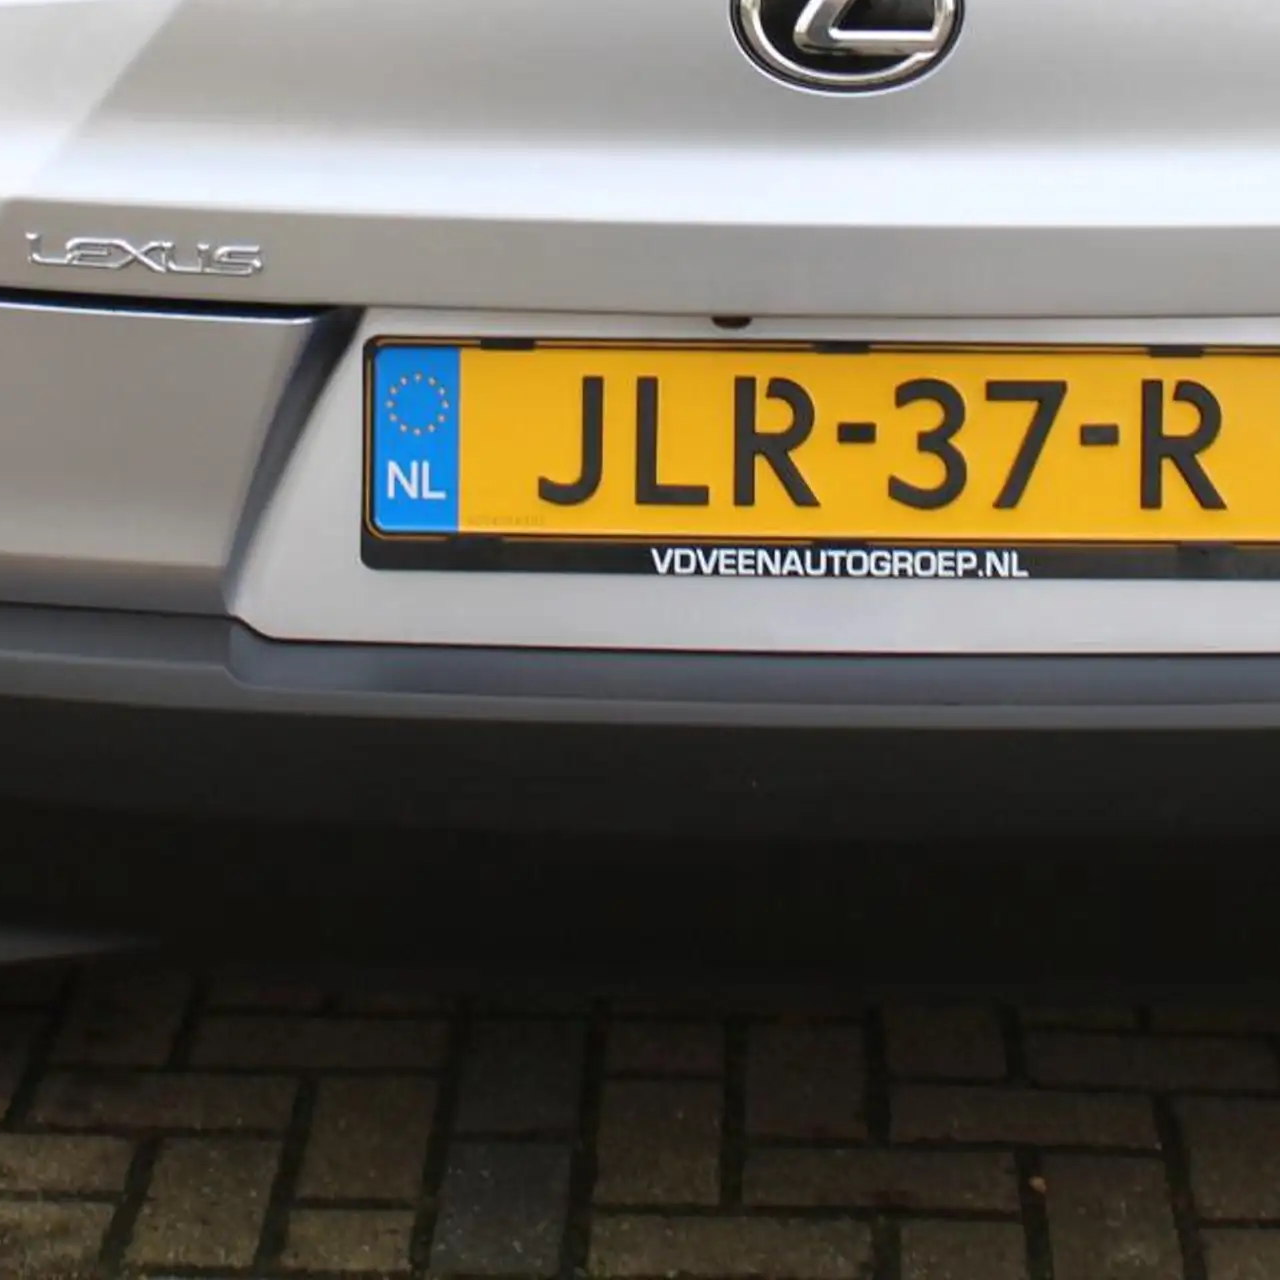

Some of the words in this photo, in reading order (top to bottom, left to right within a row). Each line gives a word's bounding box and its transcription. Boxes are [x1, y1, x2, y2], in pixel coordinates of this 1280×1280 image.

[24, 231, 264, 278] LEXUS
[535, 375, 1228, 511] JLR-37-R
[387, 459, 448, 500] NL
[650, 547, 1029, 578] VDVEENAUTOGROEP.NL
